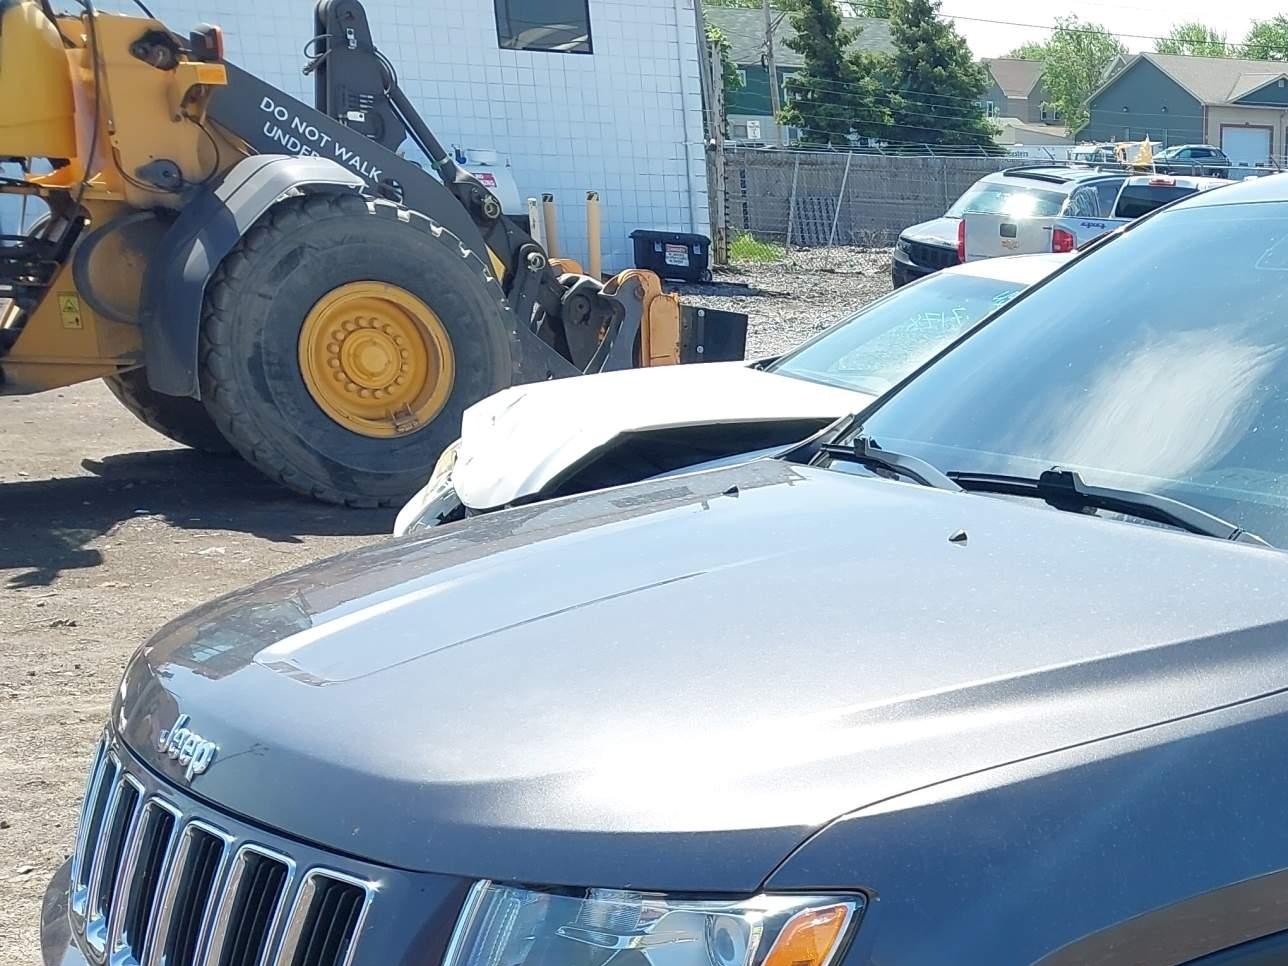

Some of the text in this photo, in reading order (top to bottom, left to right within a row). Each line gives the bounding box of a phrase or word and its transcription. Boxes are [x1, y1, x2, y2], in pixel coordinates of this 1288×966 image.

[259, 97, 382, 183] DO NOT WALK
[158, 713, 217, 783] Jeep
